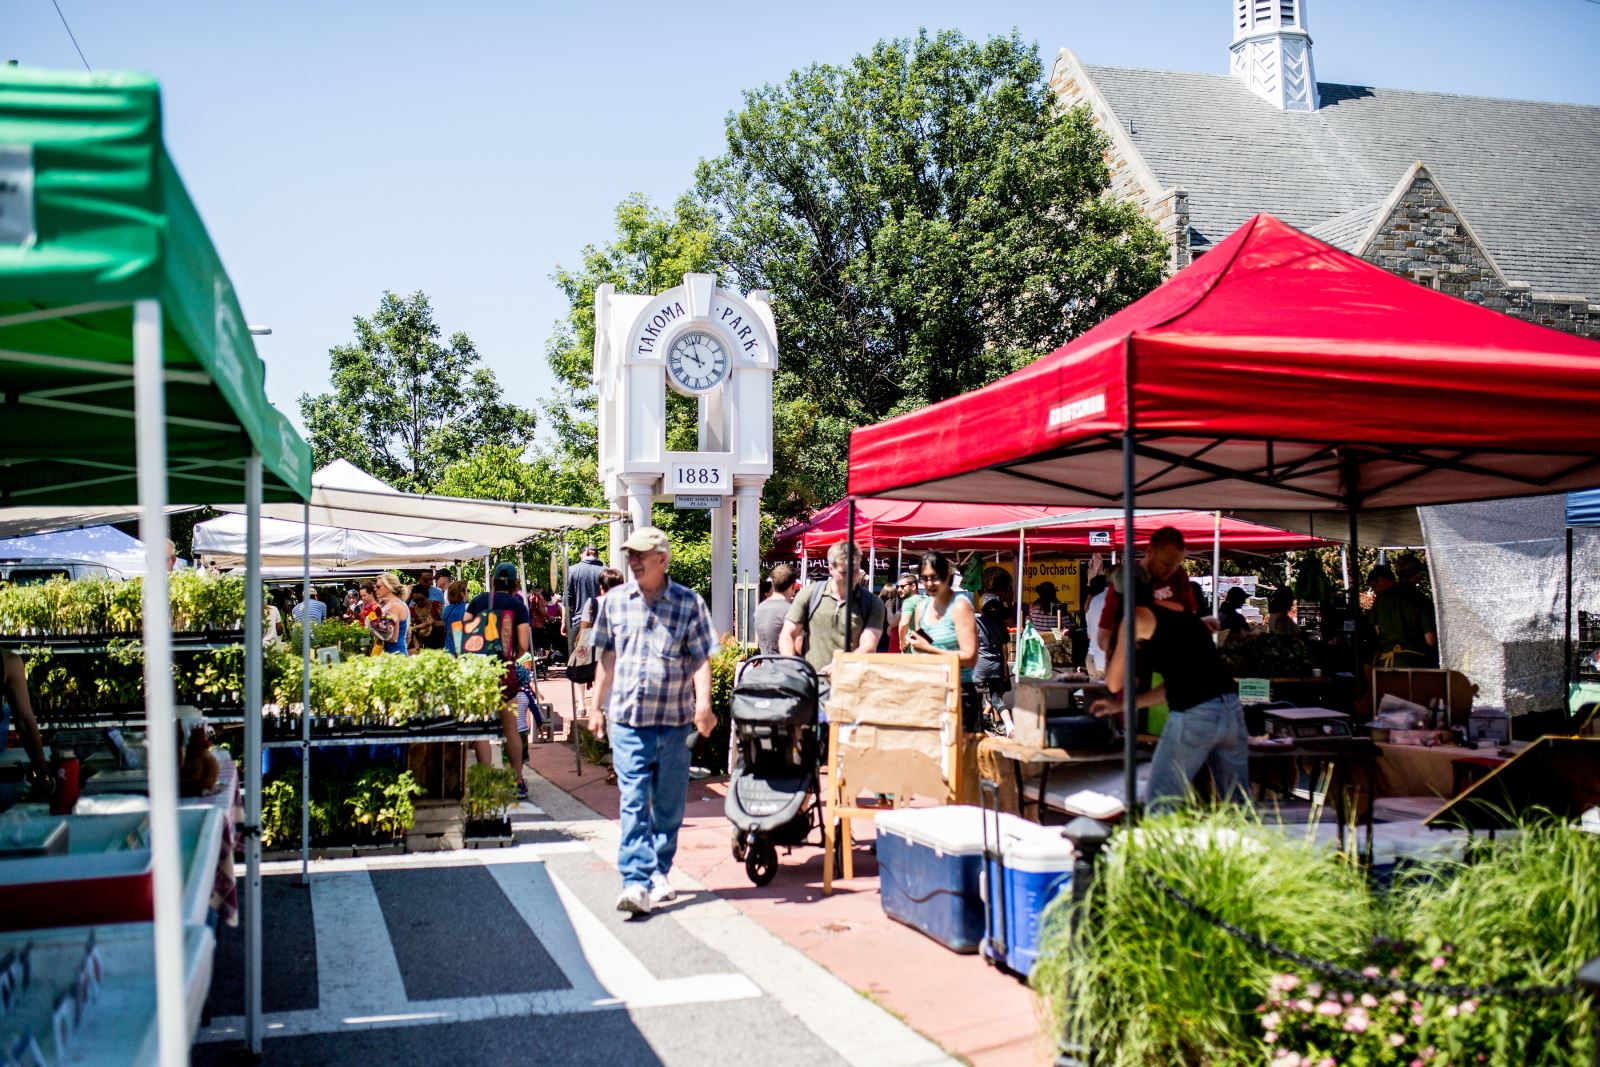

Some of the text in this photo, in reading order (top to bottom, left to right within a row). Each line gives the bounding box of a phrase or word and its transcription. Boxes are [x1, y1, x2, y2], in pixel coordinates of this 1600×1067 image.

[638, 302, 685, 354] TAKOMA
[678, 469, 719, 484] 1883
[1039, 563, 1077, 576] Orchards
